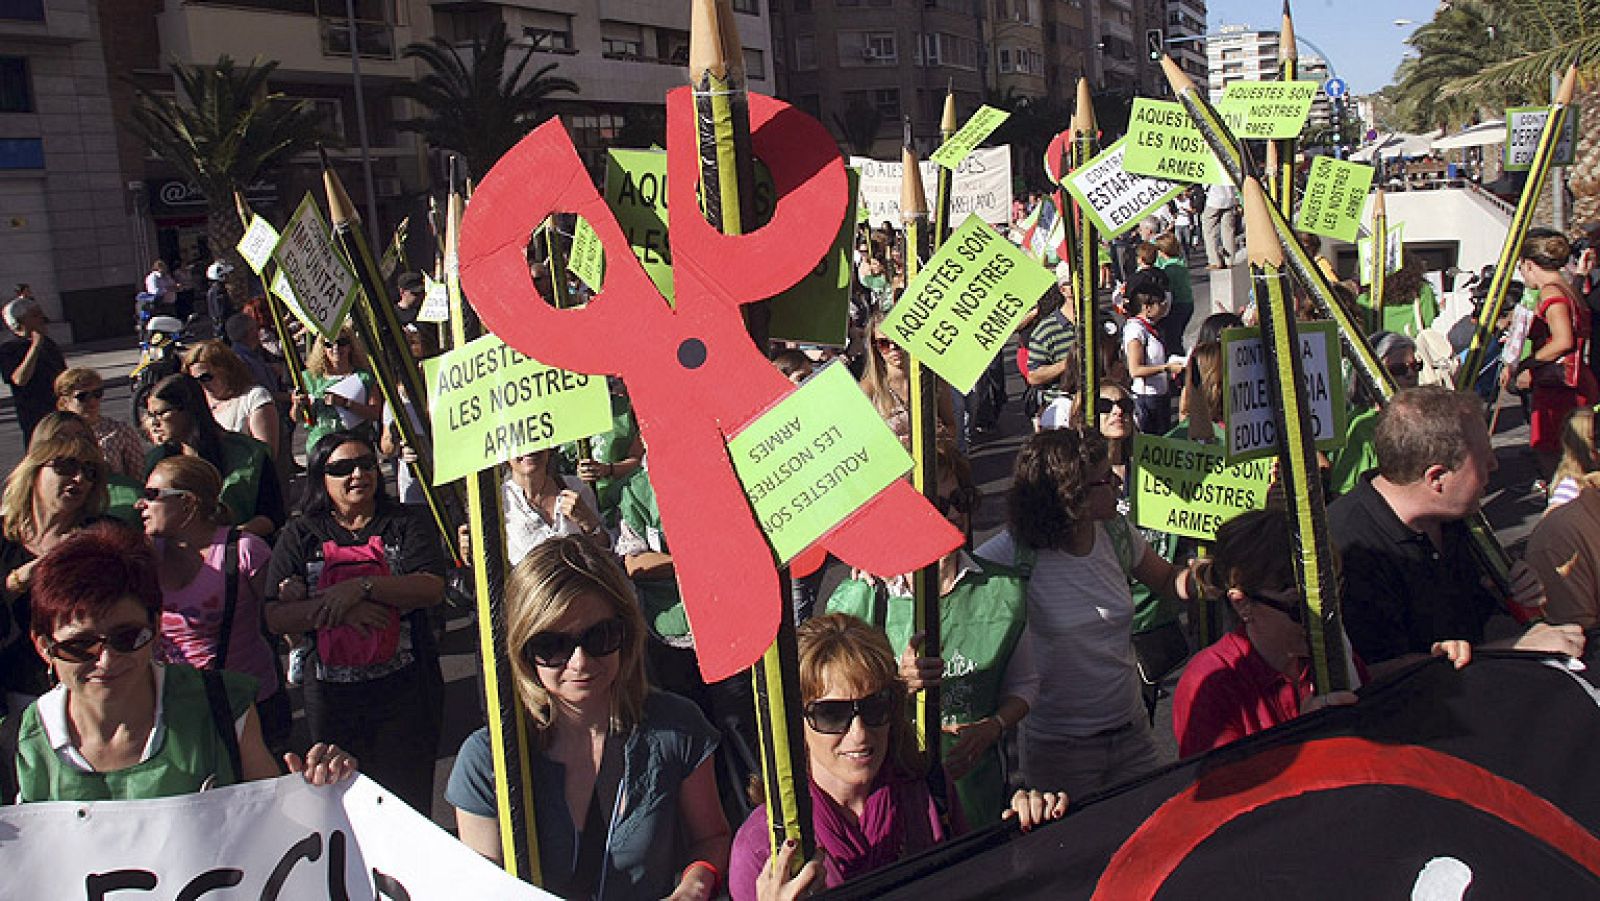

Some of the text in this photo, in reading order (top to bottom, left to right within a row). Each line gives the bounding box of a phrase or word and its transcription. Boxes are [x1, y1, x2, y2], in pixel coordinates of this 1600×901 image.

[1227, 87, 1284, 99] AQUESTES
[1248, 104, 1302, 117] NOSTRES
[1136, 108, 1200, 131] AQUESTE
[1246, 122, 1275, 135] RMES
[1138, 131, 1210, 154] LES NOST
[1156, 157, 1205, 178] ARMES
[1110, 180, 1174, 226] EDUCAC
[895, 258, 965, 342] AQUESTES
[958, 225, 994, 262] SÓN
[924, 253, 1015, 355] LES NOSTRES
[974, 292, 1024, 350] ARMES
[438, 343, 532, 396] AQUESTE
[449, 368, 589, 431] LES NOSTRES
[484, 410, 555, 459] ARMES
[749, 416, 801, 464] ARMES
[1235, 409, 1321, 451] EDUCÓ
[749, 424, 843, 503] LES NOSTRES
[791, 446, 871, 513] AQUESTES
[1140, 445, 1224, 475] AQUESTES
[1144, 475, 1255, 509] LES NOSTRES
[1167, 508, 1223, 533] ARMES
